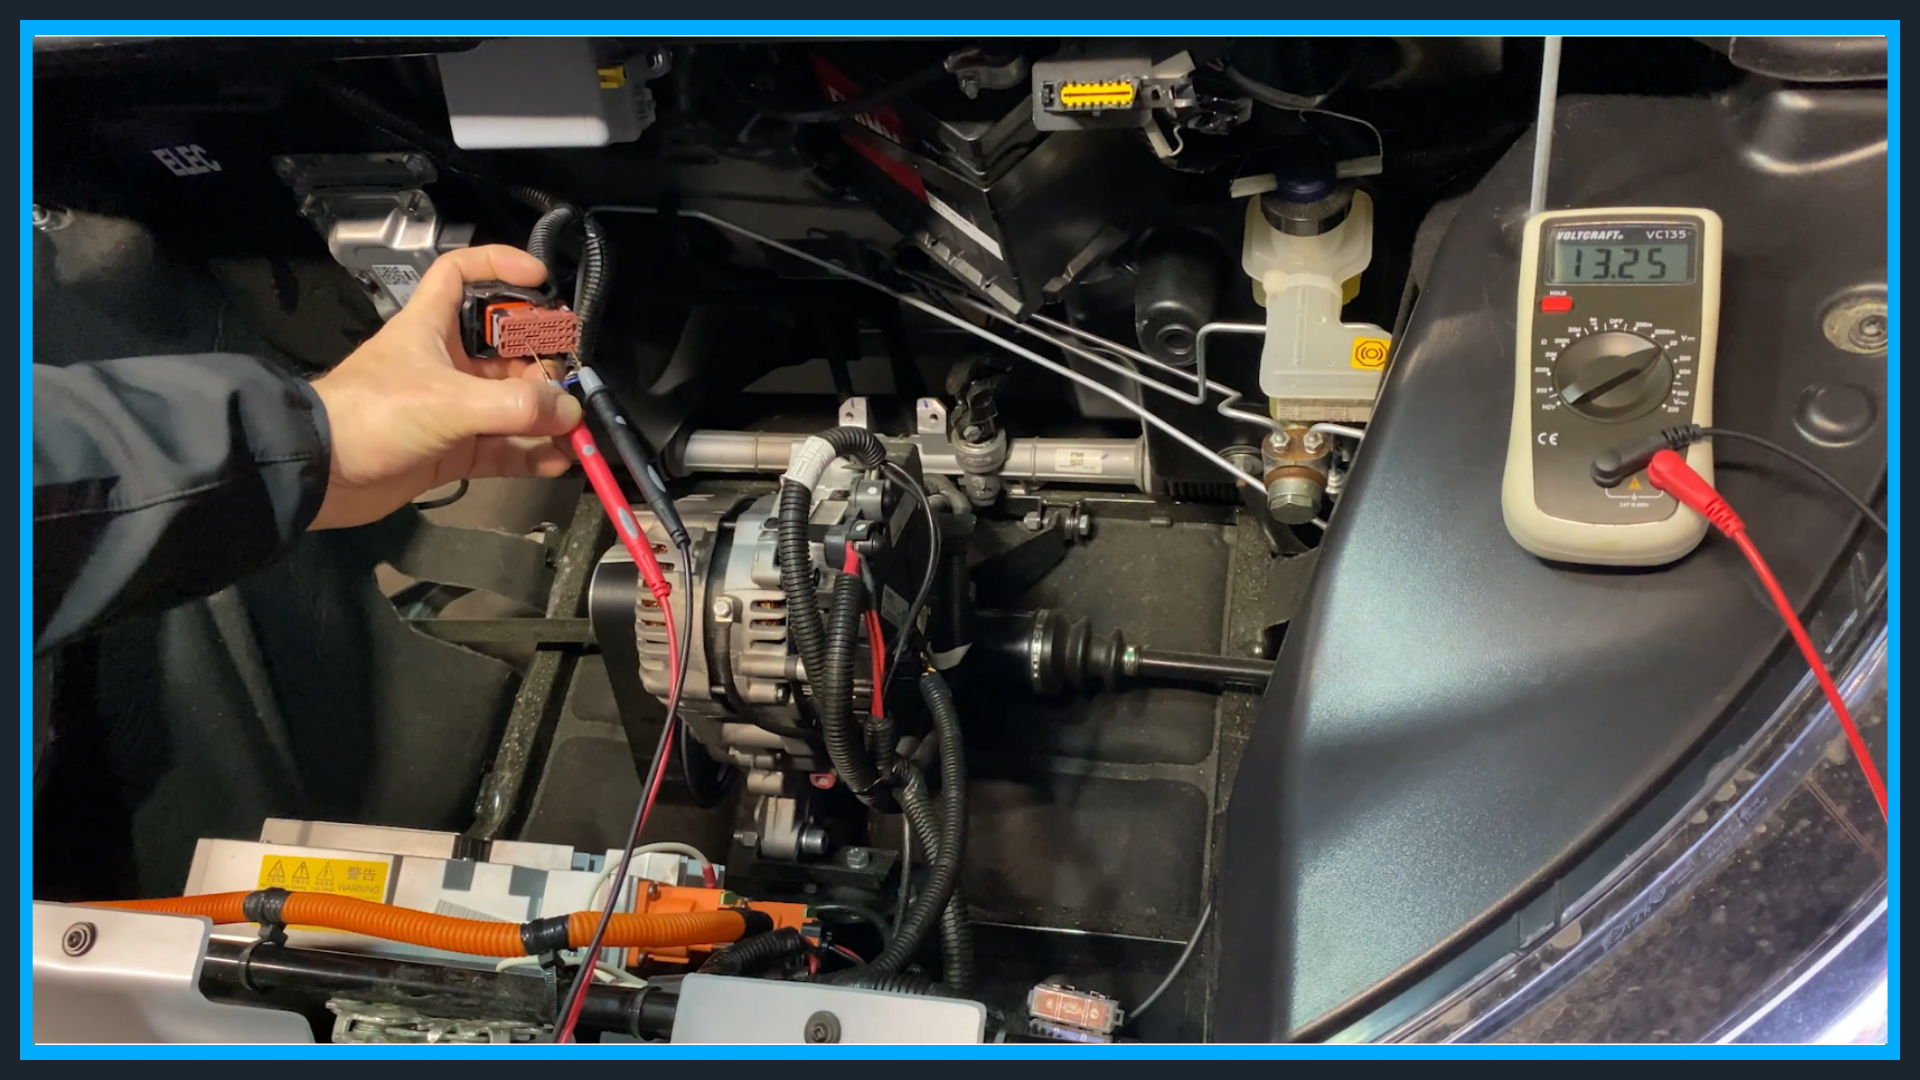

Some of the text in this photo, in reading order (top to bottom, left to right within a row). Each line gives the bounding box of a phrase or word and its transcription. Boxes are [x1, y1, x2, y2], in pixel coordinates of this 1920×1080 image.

[151, 144, 222, 177] ELEC
[1557, 230, 1620, 240] VOLTCRAFT
[1646, 230, 1687, 239] VC135
[1574, 247, 1666, 279] 13.25
[1537, 432, 1559, 446] CE
[337, 883, 380, 895] WARNING
